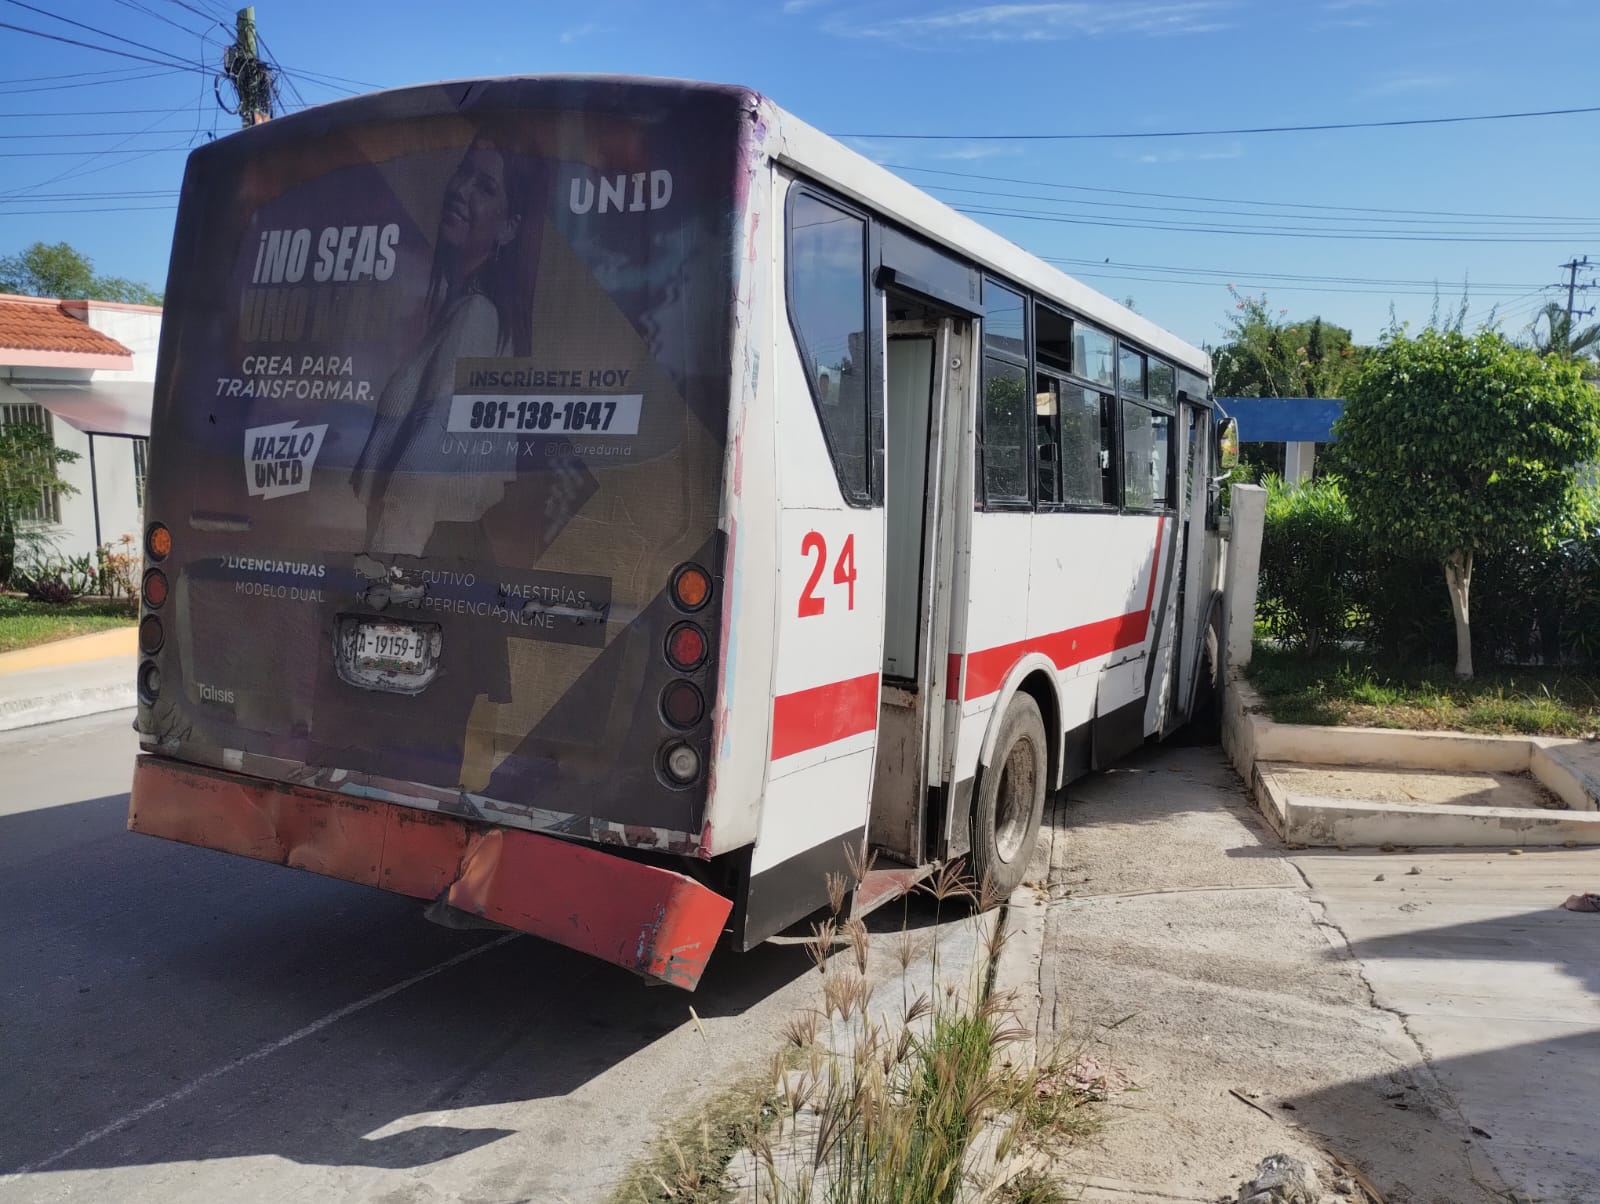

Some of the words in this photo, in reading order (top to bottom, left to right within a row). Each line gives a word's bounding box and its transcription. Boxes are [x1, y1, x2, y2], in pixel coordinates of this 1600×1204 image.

[569, 169, 673, 215] UNID
[252, 228, 312, 284] ¡NO
[313, 223, 400, 282] SEAS
[242, 356, 293, 375] CREA
[300, 356, 353, 376] PARA
[469, 368, 582, 388] INSCRÍBETE
[588, 369, 630, 387] HOY
[215, 378, 375, 401] TRANSFORMAR.
[470, 401, 617, 431] 981-138-1647
[251, 432, 315, 462] HAZLO
[442, 440, 493, 456] UNID
[505, 440, 536, 457] MX
[255, 459, 303, 489] UNID
[228, 556, 326, 577] LICENCIATURAS
[798, 531, 857, 618] 24
[235, 581, 287, 599] MODELO
[291, 587, 326, 602] DUAL
[500, 582, 586, 604] MAESTRÍAS
[197, 682, 235, 703] Talisis
